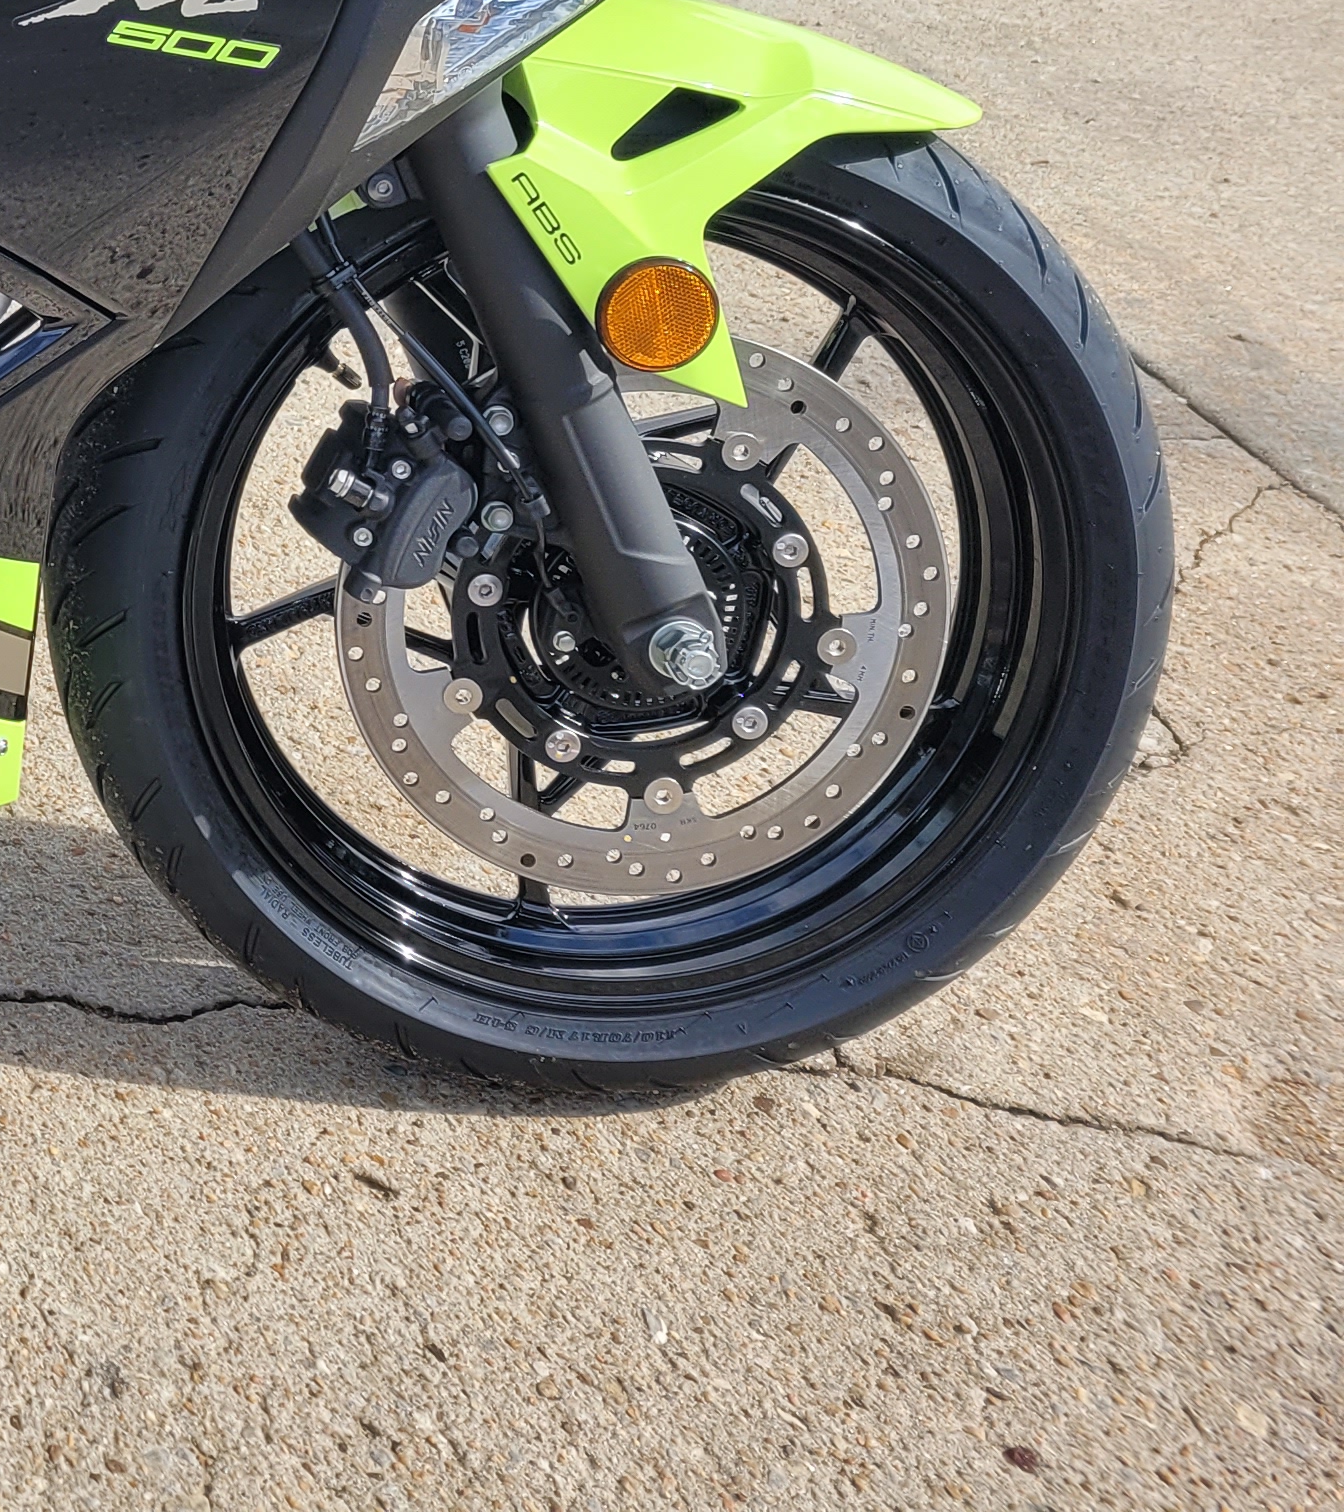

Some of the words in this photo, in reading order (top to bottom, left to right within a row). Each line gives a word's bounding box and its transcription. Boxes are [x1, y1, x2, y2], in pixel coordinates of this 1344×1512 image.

[107, 20, 281, 69] 500
[511, 171, 582, 266] ABS
[260, 883, 292, 920] RADIAL
[301, 927, 353, 971] TUBELESS
[314, 924, 338, 947] FRONT
